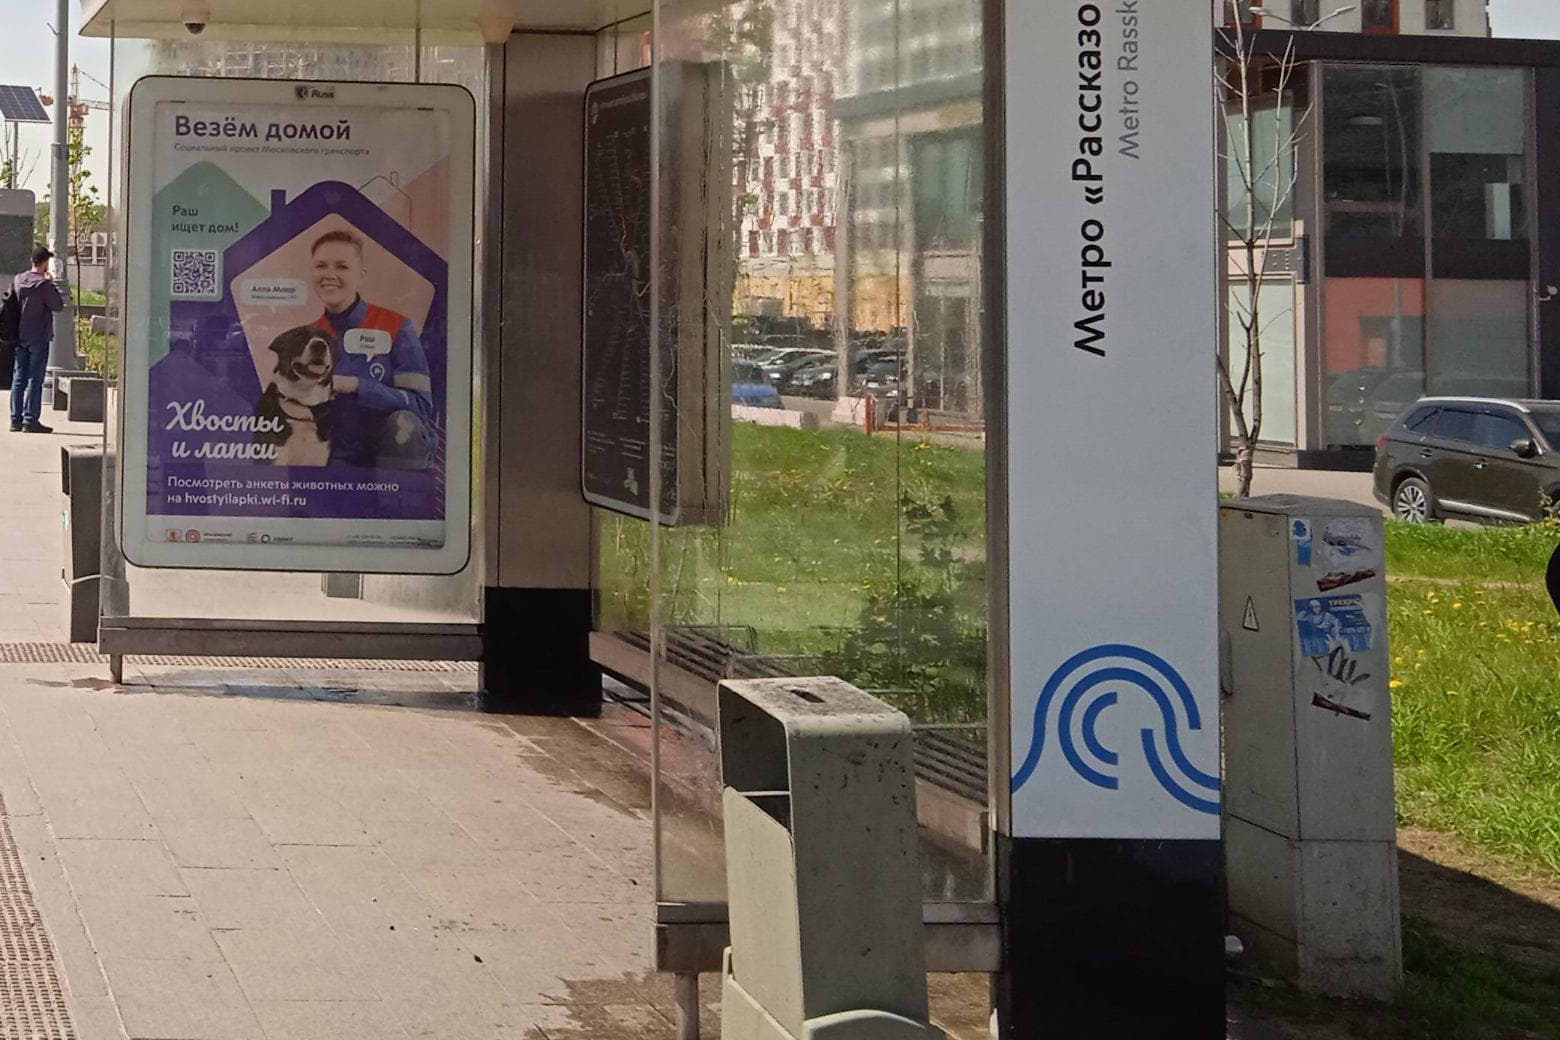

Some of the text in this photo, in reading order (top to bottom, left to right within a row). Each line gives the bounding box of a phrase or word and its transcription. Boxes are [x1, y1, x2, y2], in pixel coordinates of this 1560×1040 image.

[175, 115, 351, 142] Везём домой
[1117, 80, 1140, 160] Metro
[172, 205, 198, 216] Раш
[172, 222, 239, 234] ищет дом!
[1074, 218, 1112, 358] Метро
[166, 399, 284, 433] Хвосты
[172, 441, 279, 460] и лапки
[168, 476, 400, 492] Посмотреть анкеты животных можно
[168, 492, 307, 506] на hvostyilapki.wi-fi.ru
